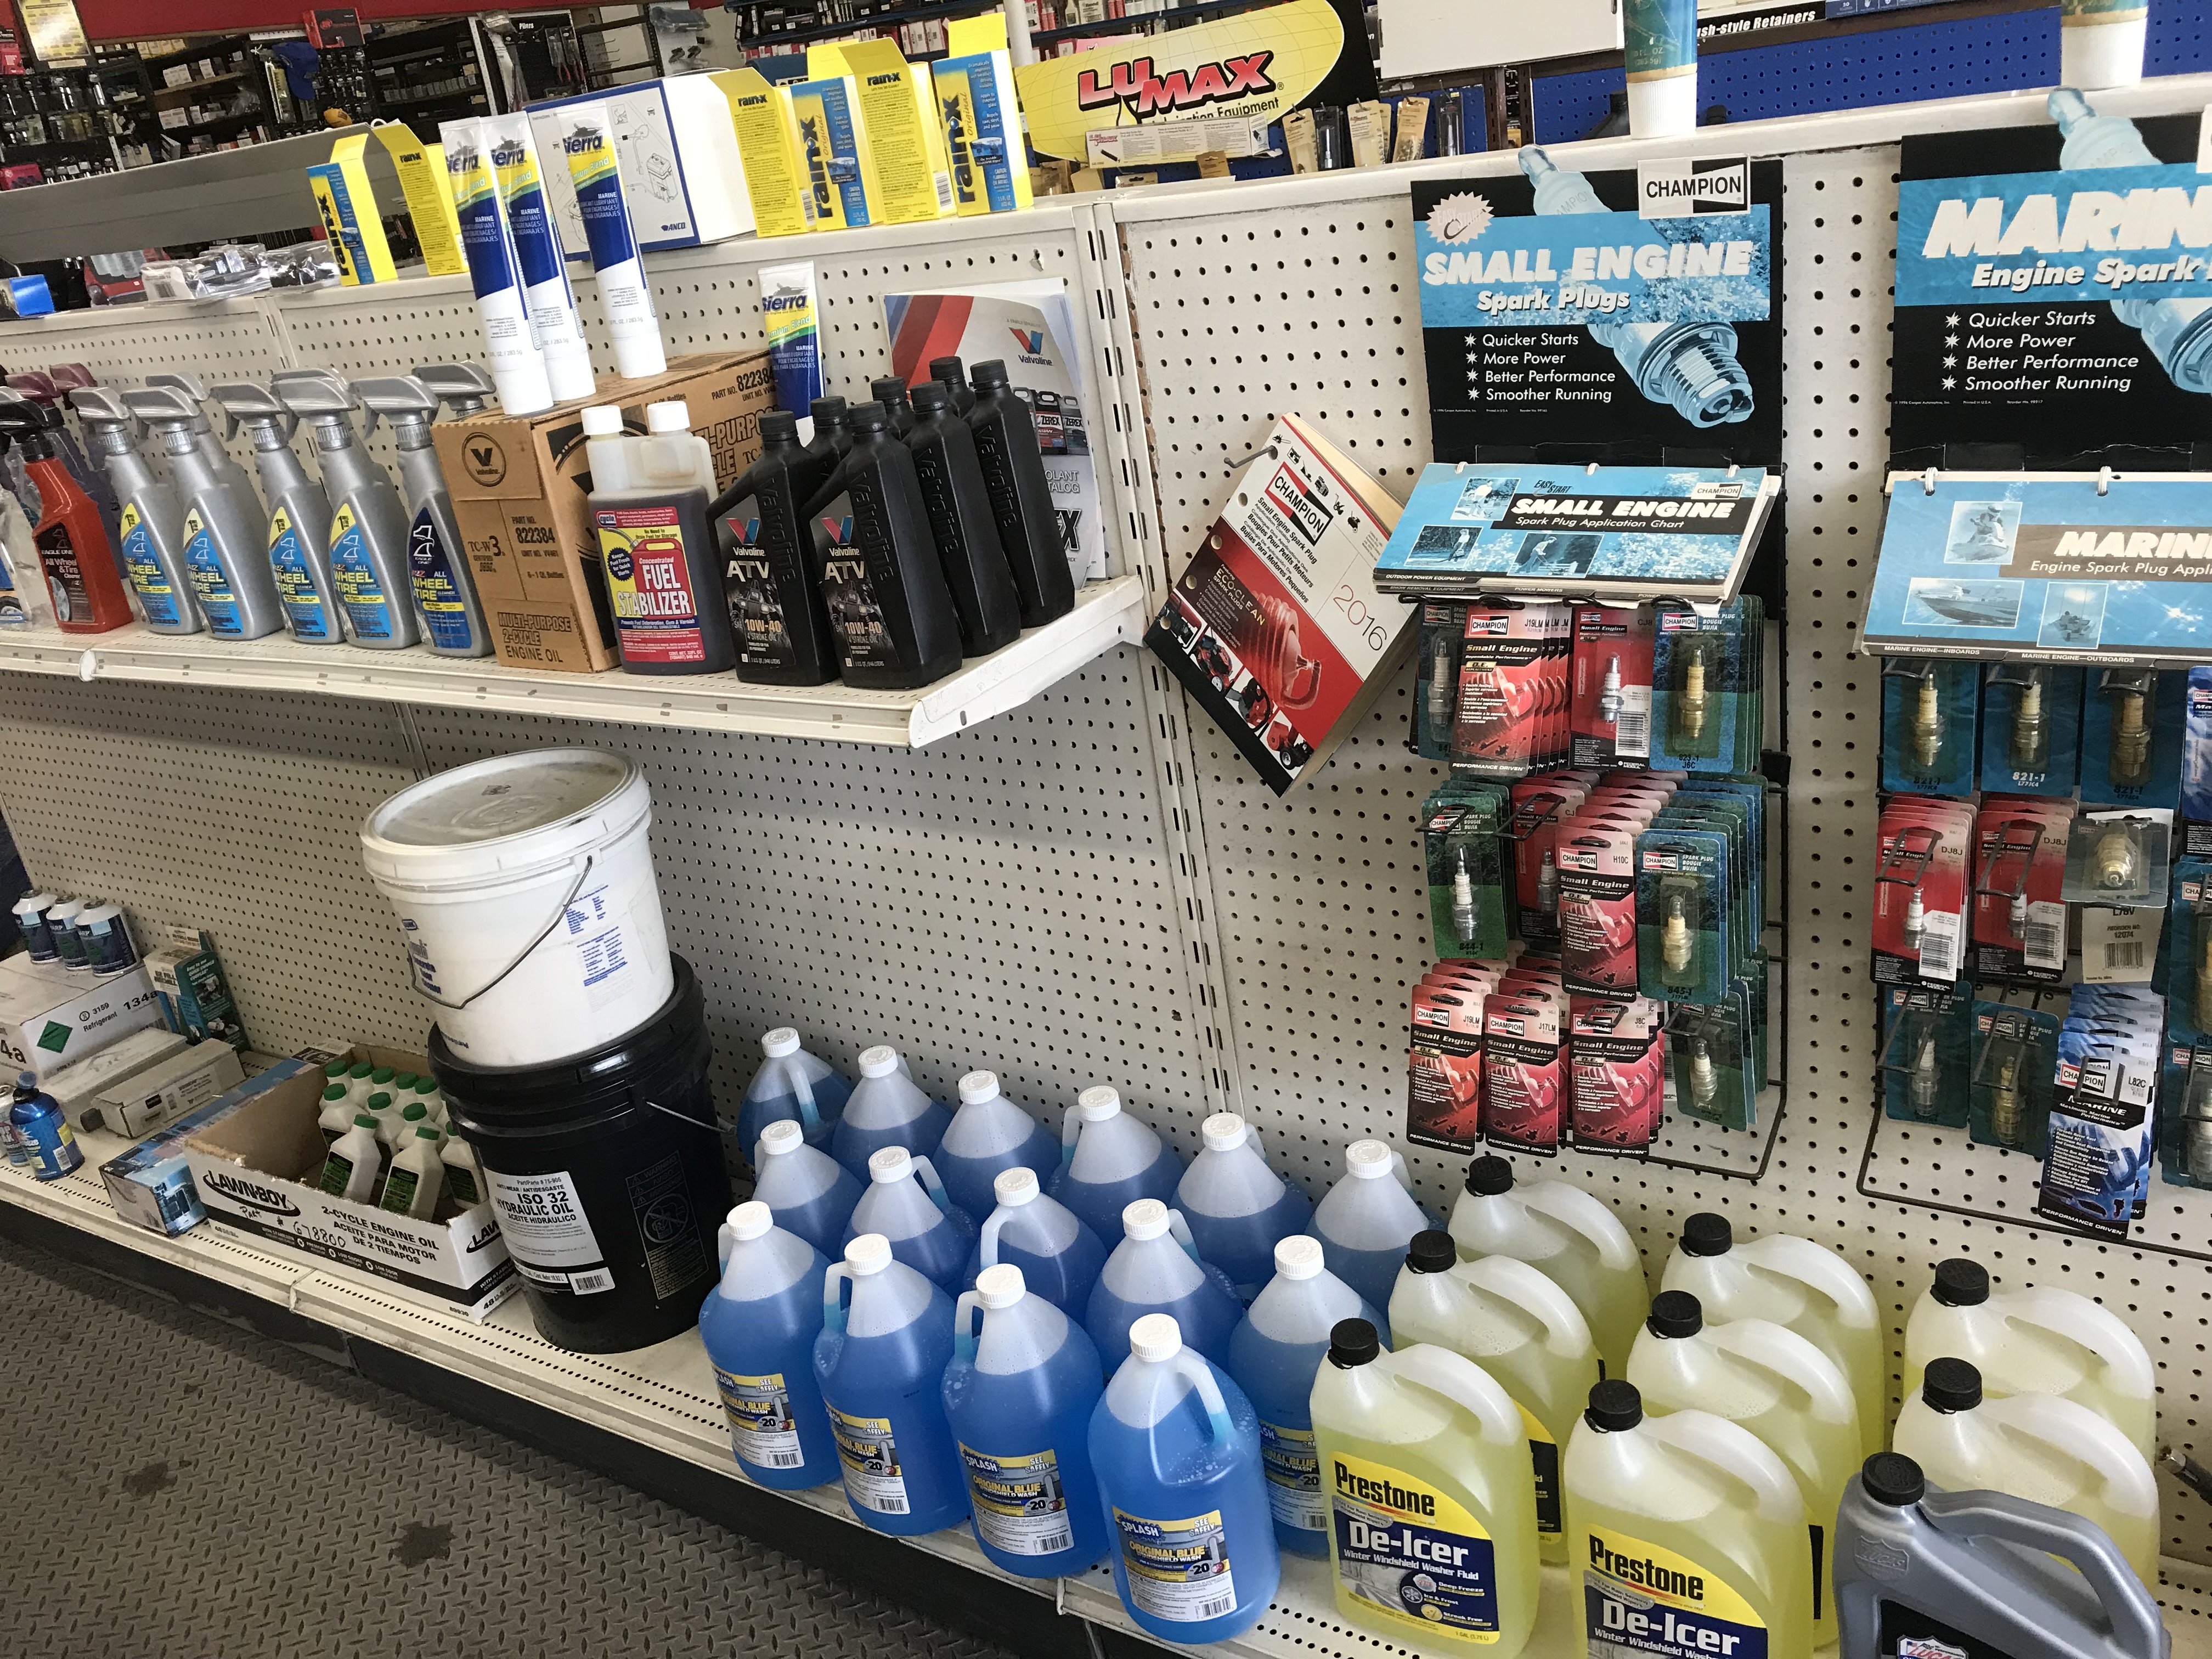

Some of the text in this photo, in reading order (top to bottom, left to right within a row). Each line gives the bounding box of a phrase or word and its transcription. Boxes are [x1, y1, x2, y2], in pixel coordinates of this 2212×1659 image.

[1753, 10, 1815, 29] Retainers
[1078, 50, 1277, 117] LUMAX
[1217, 97, 1279, 118] Equipment
[589, 157, 610, 173] Blend
[1646, 176, 1742, 199] CHAMPION
[668, 222, 686, 232] ANCO
[1423, 240, 1756, 285] SMALL ENGINE
[1971, 255, 2201, 293] Engine Spark
[1477, 288, 1630, 316] Spark Plugs
[791, 314, 811, 329] Blend
[1968, 311, 2096, 329] Quicker Starts
[1482, 332, 1579, 347] Quicker Starts
[1966, 333, 2076, 349] More Power
[1018, 354, 1054, 366] Valvoline
[1483, 352, 1566, 365] More Power
[1966, 354, 2139, 370] Better Performance
[1485, 370, 1616, 383] Better Performance
[1965, 375, 2132, 392] Smoother Running
[712, 388, 726, 400] PART
[1486, 388, 1612, 404] Smoother Running
[1041, 415, 1061, 427] ZEREX
[1697, 487, 1740, 495] CHAMPION
[1274, 476, 1324, 533] CHAMPION
[1511, 498, 1735, 519] SMALL ENGINE
[511, 516, 526, 524] PART
[1515, 517, 1685, 529] Spark Plug Application Chart
[516, 527, 555, 544] 822384
[1257, 497, 1318, 565] Small Engine Spark Plug
[733, 547, 766, 557] Valvoline
[829, 547, 860, 557] Valvoline
[1247, 514, 1314, 588] Bougies Pour Petits Moteurs
[726, 560, 769, 582] ATV
[825, 561, 865, 584] ATV
[1240, 526, 1309, 604] Bujías Para Motores Pequeños
[2030, 561, 2168, 576] Engine Spark Plug
[334, 572, 374, 583] WHEEL
[413, 577, 452, 589] WHEEL
[642, 563, 681, 590] FUEL
[1213, 575, 1243, 610] SPARK PLUGS
[617, 590, 692, 616] STABILIZER
[498, 612, 572, 633] MULTI-PURPOSE
[1333, 584, 1389, 651] 2016
[1472, 619, 1543, 629] CHAMPION J19LM
[744, 619, 782, 633] 10W-40
[845, 621, 882, 634] 10W-40
[503, 629, 541, 646] 2-CYCLE
[505, 645, 563, 663] ENGINE OIL
[1499, 645, 1537, 653] Engine
[2012, 771, 2045, 782] 821-1
[2044, 837, 2067, 846] DJ8J
[1941, 846, 1963, 856] DJ8J
[1562, 854, 1629, 865] CHAMPION H10C
[1560, 875, 1630, 889] Small Engine
[2114, 930, 2134, 939] 12074
[123, 990, 158, 1011] 134a
[92, 1003, 110, 1015] 3159
[83, 1011, 118, 1032] Refrigerant
[1418, 1010, 1480, 1025] CHAMPION J19LM
[1634, 1017, 1646, 1025] J8C
[1491, 1020, 1556, 1032] CHAMPION J17LM
[2128, 1076, 2147, 1088] L82C
[517, 1191, 569, 1205] ISO 32
[495, 1197, 574, 1216] HYDRAULIC OIL
[507, 1213, 529, 1223] ACEITE
[2041, 1207, 2123, 1235] PERFORMANCE DRIVEN
[321, 1206, 439, 1250] 2-CYCLE ENGINE OIL
[333, 1221, 437, 1261] ACEITE PARA MOTOR
[353, 1237, 421, 1265] DE 2 TIEMPOS
[966, 1456, 997, 1472] SPLASH
[973, 1475, 1041, 1493] ORIGINAL BLUE
[1334, 1460, 1435, 1516] Prestone
[1027, 1499, 1046, 1510] -20
[1121, 1521, 1159, 1537] SPLASH
[1194, 1517, 1209, 1528] SEE
[1128, 1540, 1205, 1558] ORIGINAL BLUE
[1349, 1520, 1469, 1567] De-Icer
[1189, 1564, 1210, 1575] -20
[1344, 1549, 1479, 1580] Winter Windshield Washer Fluid
[1589, 1533, 1703, 1601] Prestone
[1602, 1598, 1740, 1656] De-Icer
[1595, 1627, 1626, 1643] Winter
[1629, 1634, 1682, 1657] Windshield
